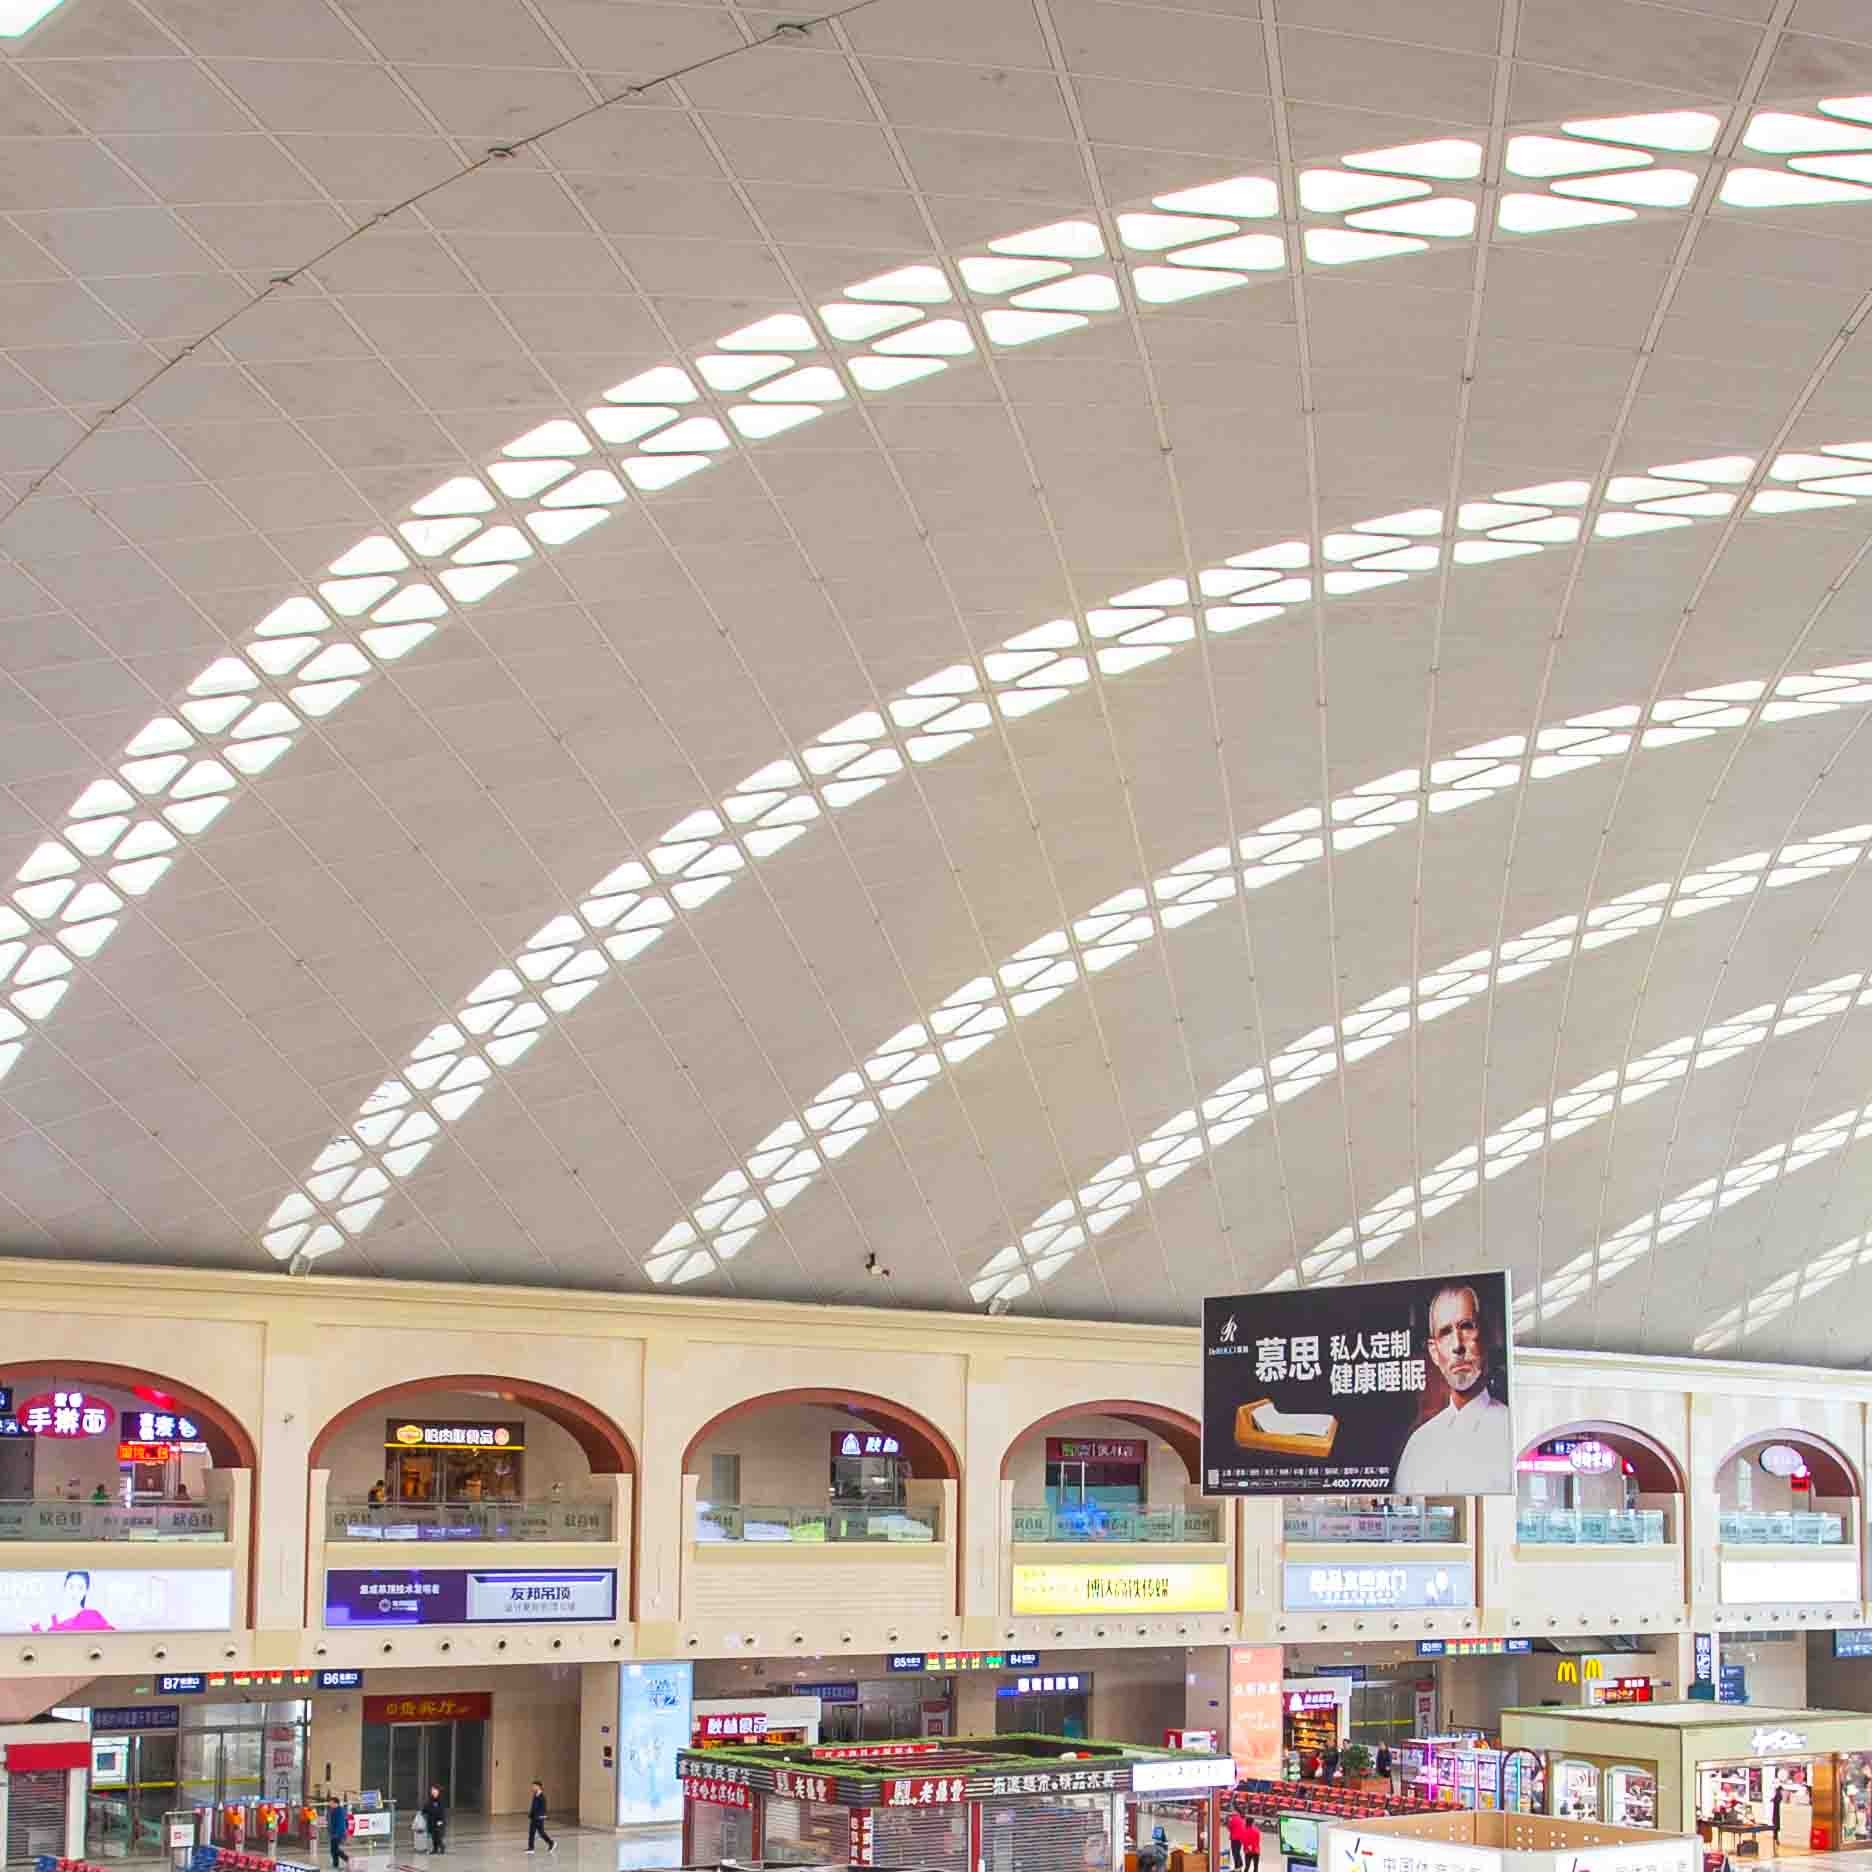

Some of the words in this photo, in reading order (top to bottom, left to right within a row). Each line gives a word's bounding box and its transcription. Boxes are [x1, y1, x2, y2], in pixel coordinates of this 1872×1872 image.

[1254, 1336, 1322, 1384] 慕思
[1329, 1330, 1410, 1361] 私人定制
[1329, 1360, 1426, 1395] 健康睡眠
[1332, 1478, 1350, 1488] 400
[1350, 1477, 1390, 1487] 7770077
[511, 1585, 571, 1601] 友邦吊顶
[164, 1679, 180, 1691] B7
[324, 1676, 338, 1690] B6
